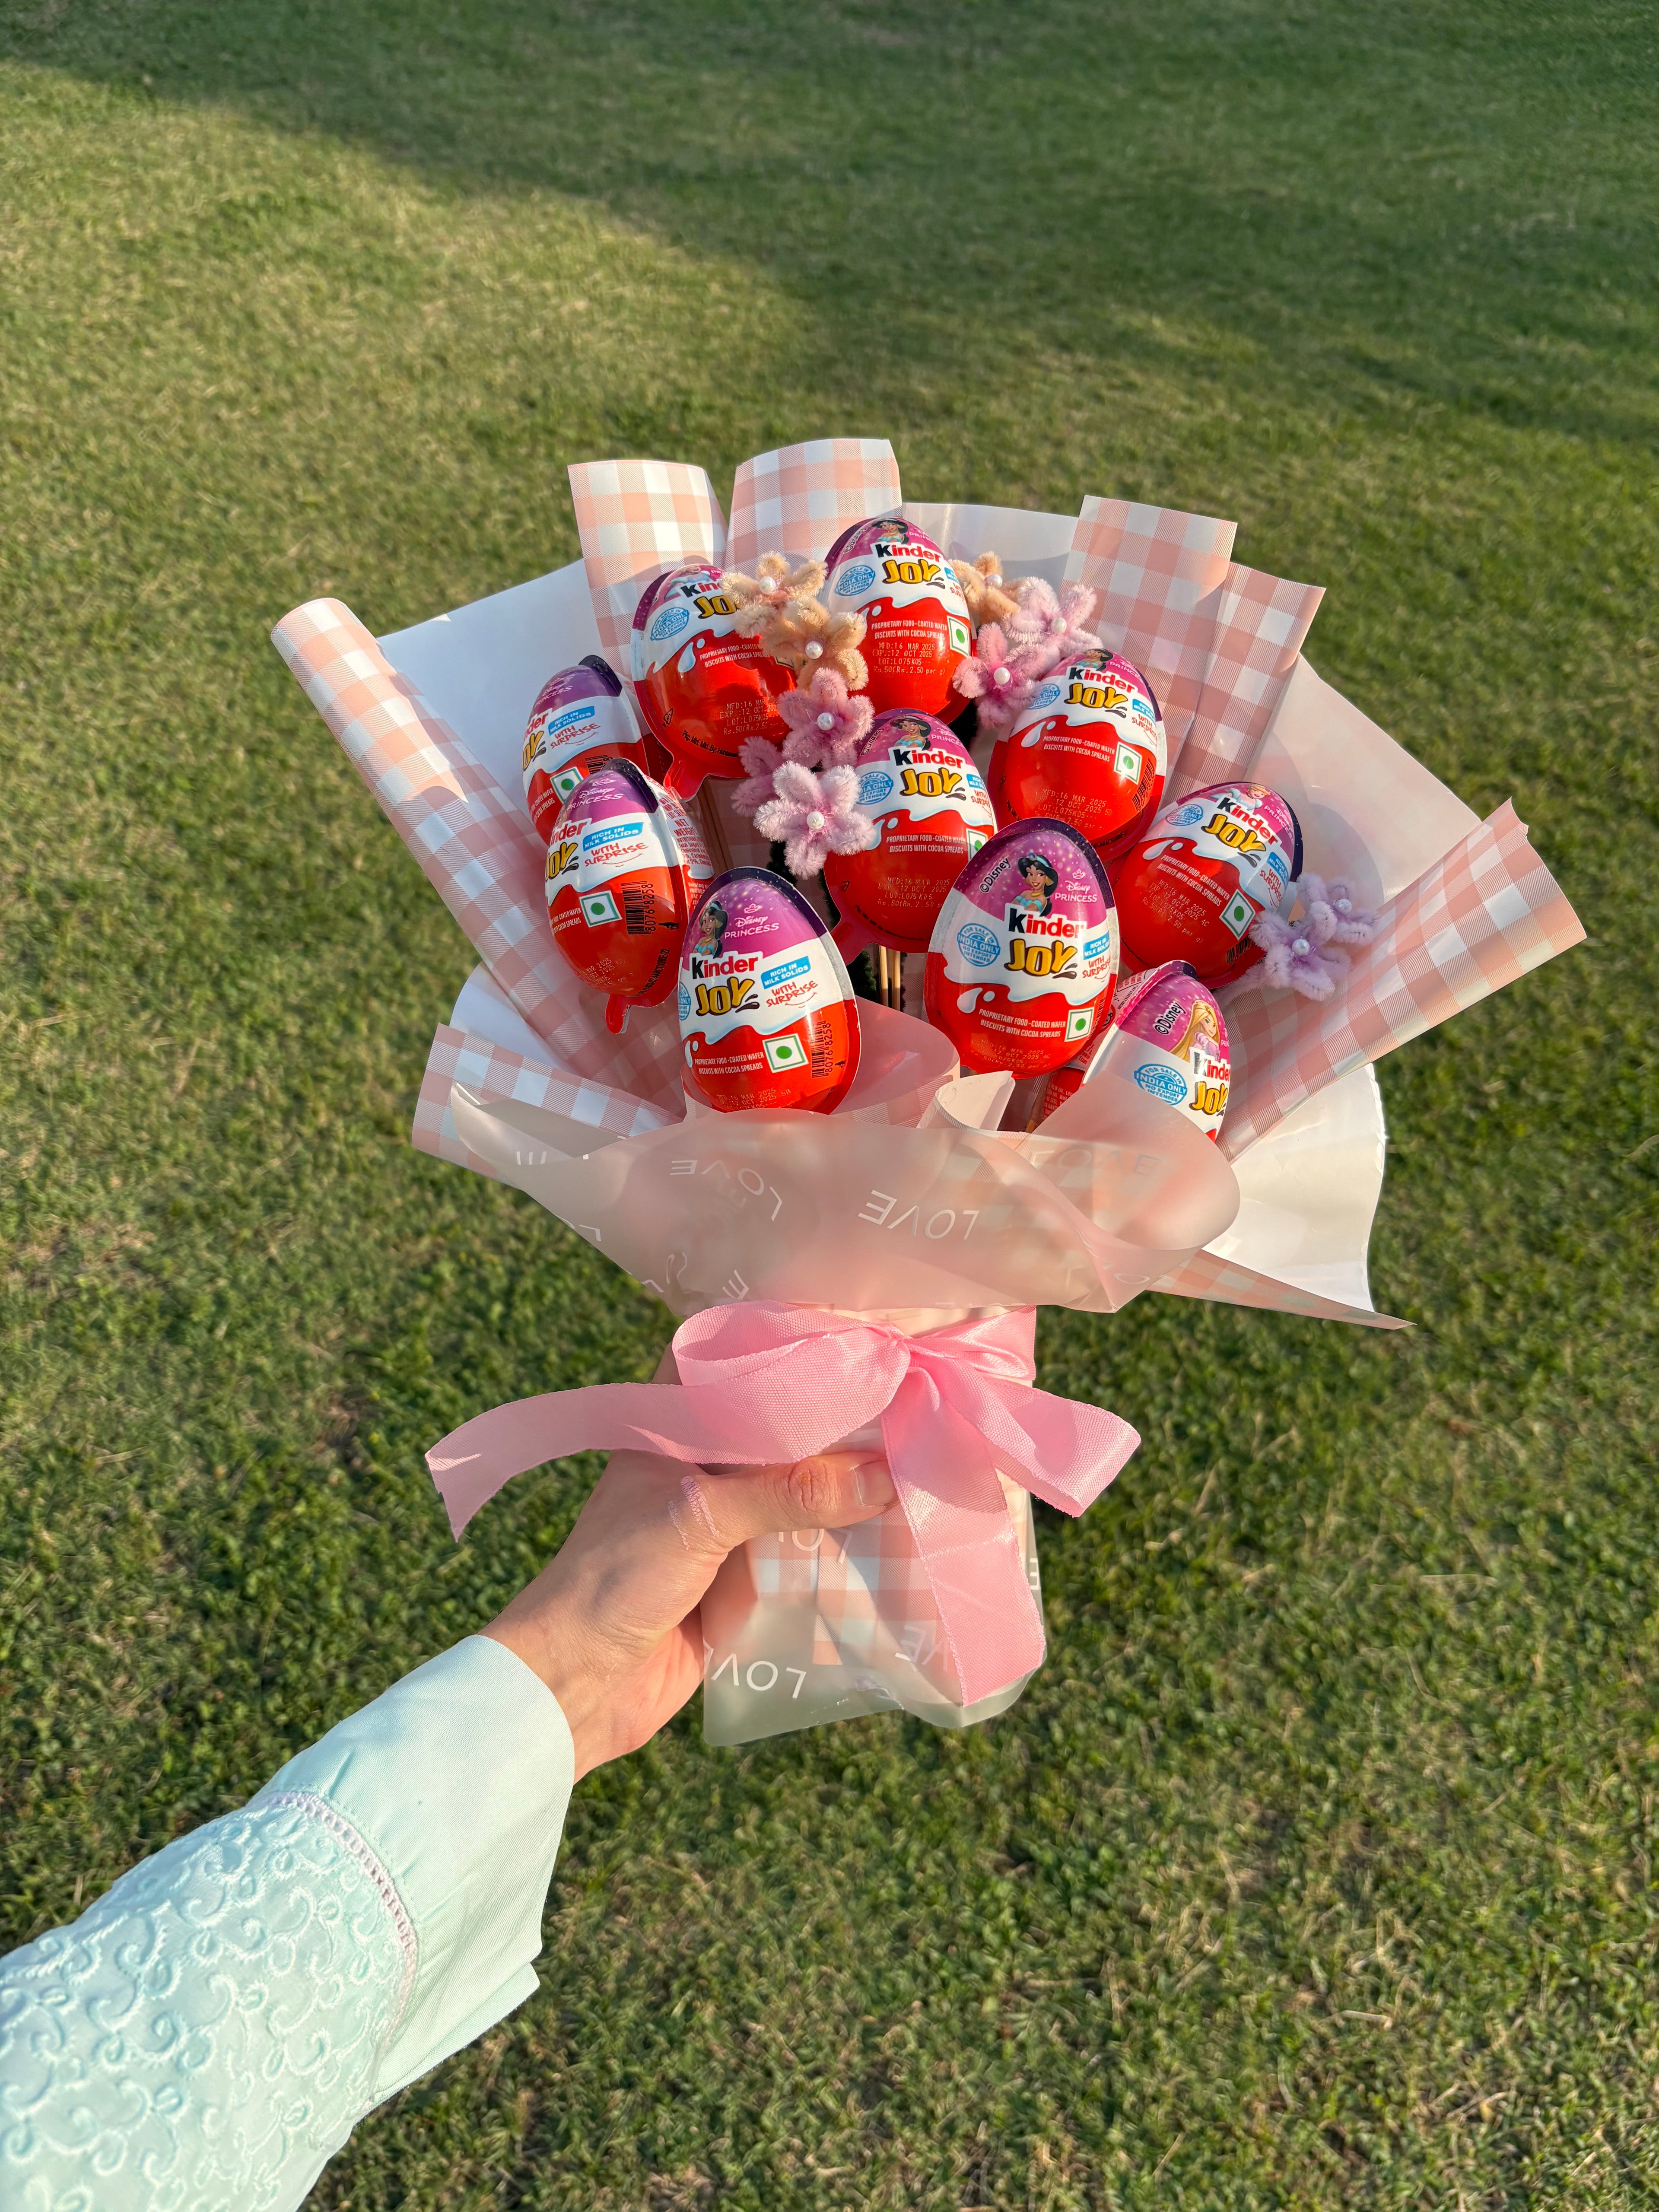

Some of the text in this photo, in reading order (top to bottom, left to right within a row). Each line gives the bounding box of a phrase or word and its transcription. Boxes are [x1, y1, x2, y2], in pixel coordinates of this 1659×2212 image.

[875, 544, 941, 562] Kinder
[858, 571, 875, 580] ONLY
[882, 559, 941, 584] JOY
[680, 582, 722, 598] Kin
[693, 595, 741, 619] JO
[871, 620, 902, 630] PROPRIETARY
[875, 630, 896, 639] BISCUITS
[927, 631, 945, 640] SPREADS
[700, 648, 727, 660] PROPRIETARY
[705, 657, 725, 667] BISCUITS
[1068, 667, 1135, 693] Kinder
[1064, 683, 1128, 709] JOY
[563, 712, 591, 725] SOLIDS
[550, 723, 601, 749] SURPRISE
[555, 725, 575, 739] WITH
[1075, 748, 1091, 756] COCOA
[1091, 751, 1110, 762] SPREADS
[1101, 745, 1115, 755] WAFER
[893, 749, 963, 769] Kinder
[874, 779, 893, 790] ONLY
[899, 767, 962, 797] JOY
[567, 794, 624, 811] PRINCESS
[1085, 805, 1102, 813] 2025
[1090, 798, 1107, 807] 2025
[1187, 811, 1203, 820] ONLY
[1217, 797, 1278, 845] Kinder
[585, 830, 639, 848] MILK SOLIDS
[591, 831, 611, 840] RICH
[886, 834, 966, 844] PROPRIETARY WAFER
[1201, 814, 1266, 853] JOY
[585, 842, 649, 867] SURPRISE
[591, 842, 619, 856] WITH
[890, 845, 912, 853] BISCUITS
[945, 846, 963, 854] SPREADS
[1065, 880, 1090, 893] Disney
[1157, 863, 1222, 907] BISCUITS WITH COCOA SPREADS
[1161, 855, 1230, 901] PROPRIETARY WAFER
[1268, 869, 1281, 889] WITH
[1055, 892, 1097, 903] PRINCESS
[1178, 893, 1207, 916] MAR 2025
[641, 884, 656, 931] 8076 8258
[1172, 898, 1200, 920] OCT 2025
[734, 916, 769, 927] Disney
[1008, 908, 1084, 938] Kinder
[725, 922, 779, 939] PRINCESS
[974, 927, 988, 937] SALE
[958, 933, 1001, 954] INDIA ONLY
[964, 951, 991, 963] INTENDED
[971, 948, 992, 958] EXPORT
[1004, 938, 1078, 977] JOY
[692, 956, 758, 979] Kinder
[1088, 956, 1104, 968] WITH
[764, 965, 809, 986] MILK SOLIDS
[770, 968, 786, 977] RICH
[695, 976, 755, 1015] JOY
[766, 980, 818, 1007] SURPRISE
[772, 982, 797, 997] WITH
[979, 1009, 1014, 1023] PROPRIETARY
[1154, 1002, 1186, 1035] ©Disney
[980, 1019, 1005, 1032] BISCUITS
[1006, 1026, 1020, 1036] WITH
[823, 1023, 833, 1073] 8076 8258
[741, 1062, 763, 1072] SPREADS
[1194, 1052, 1230, 1082] Kinde
[1136, 1072, 1186, 1093] INDIA ONLY
[1160, 1068, 1175, 1077] SALE
[1176, 1075, 1182, 1084] IN
[760, 1095, 776, 1103] 2025
[1147, 1090, 1178, 1102] INTENDED
[1157, 1089, 1180, 1098] EXPORT
[1189, 1081, 1228, 1115] JOY
[670, 1159, 783, 1222] LOVE
[857, 1189, 979, 1241] LOVE
